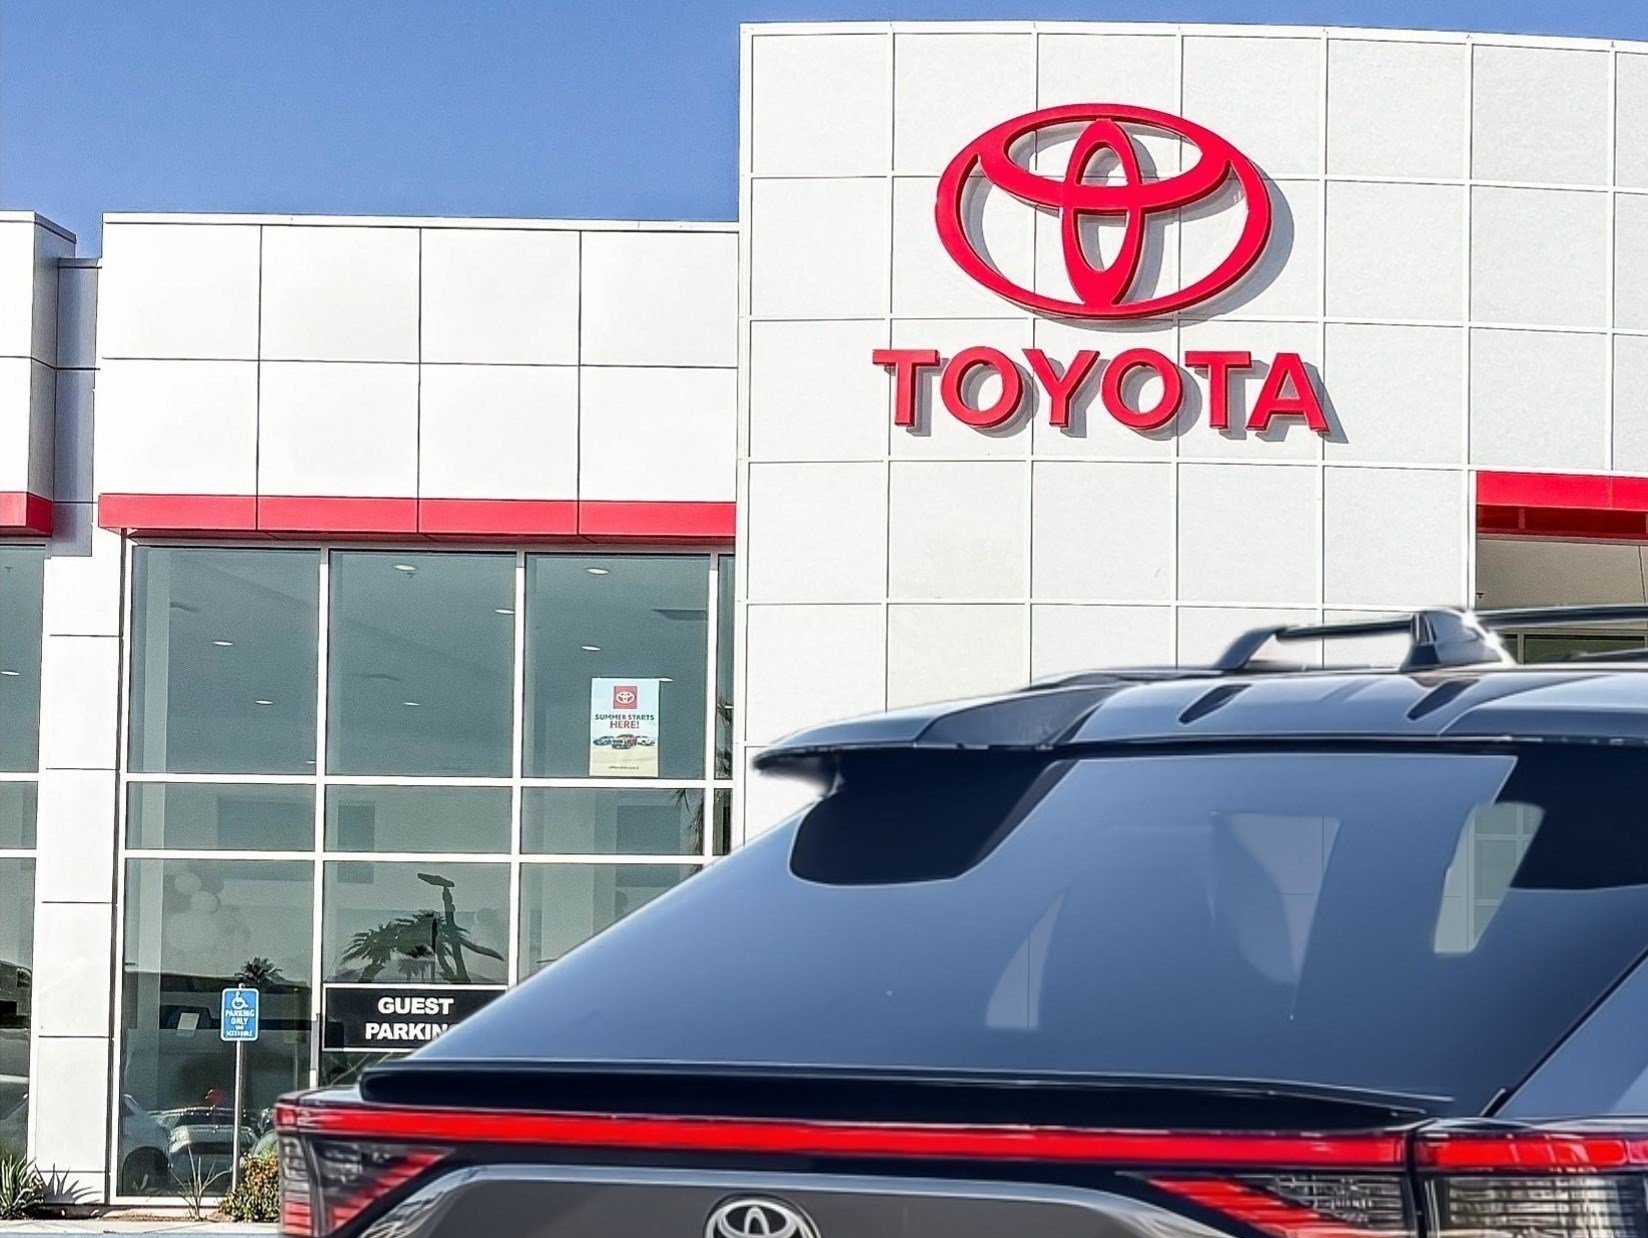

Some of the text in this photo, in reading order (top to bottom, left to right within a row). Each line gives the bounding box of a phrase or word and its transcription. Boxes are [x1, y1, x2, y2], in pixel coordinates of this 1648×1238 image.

[873, 346, 1331, 434] TOYOTA
[609, 721, 640, 729] HERE!
[377, 997, 455, 1015] GUEST
[365, 1023, 457, 1040] PARKIN
